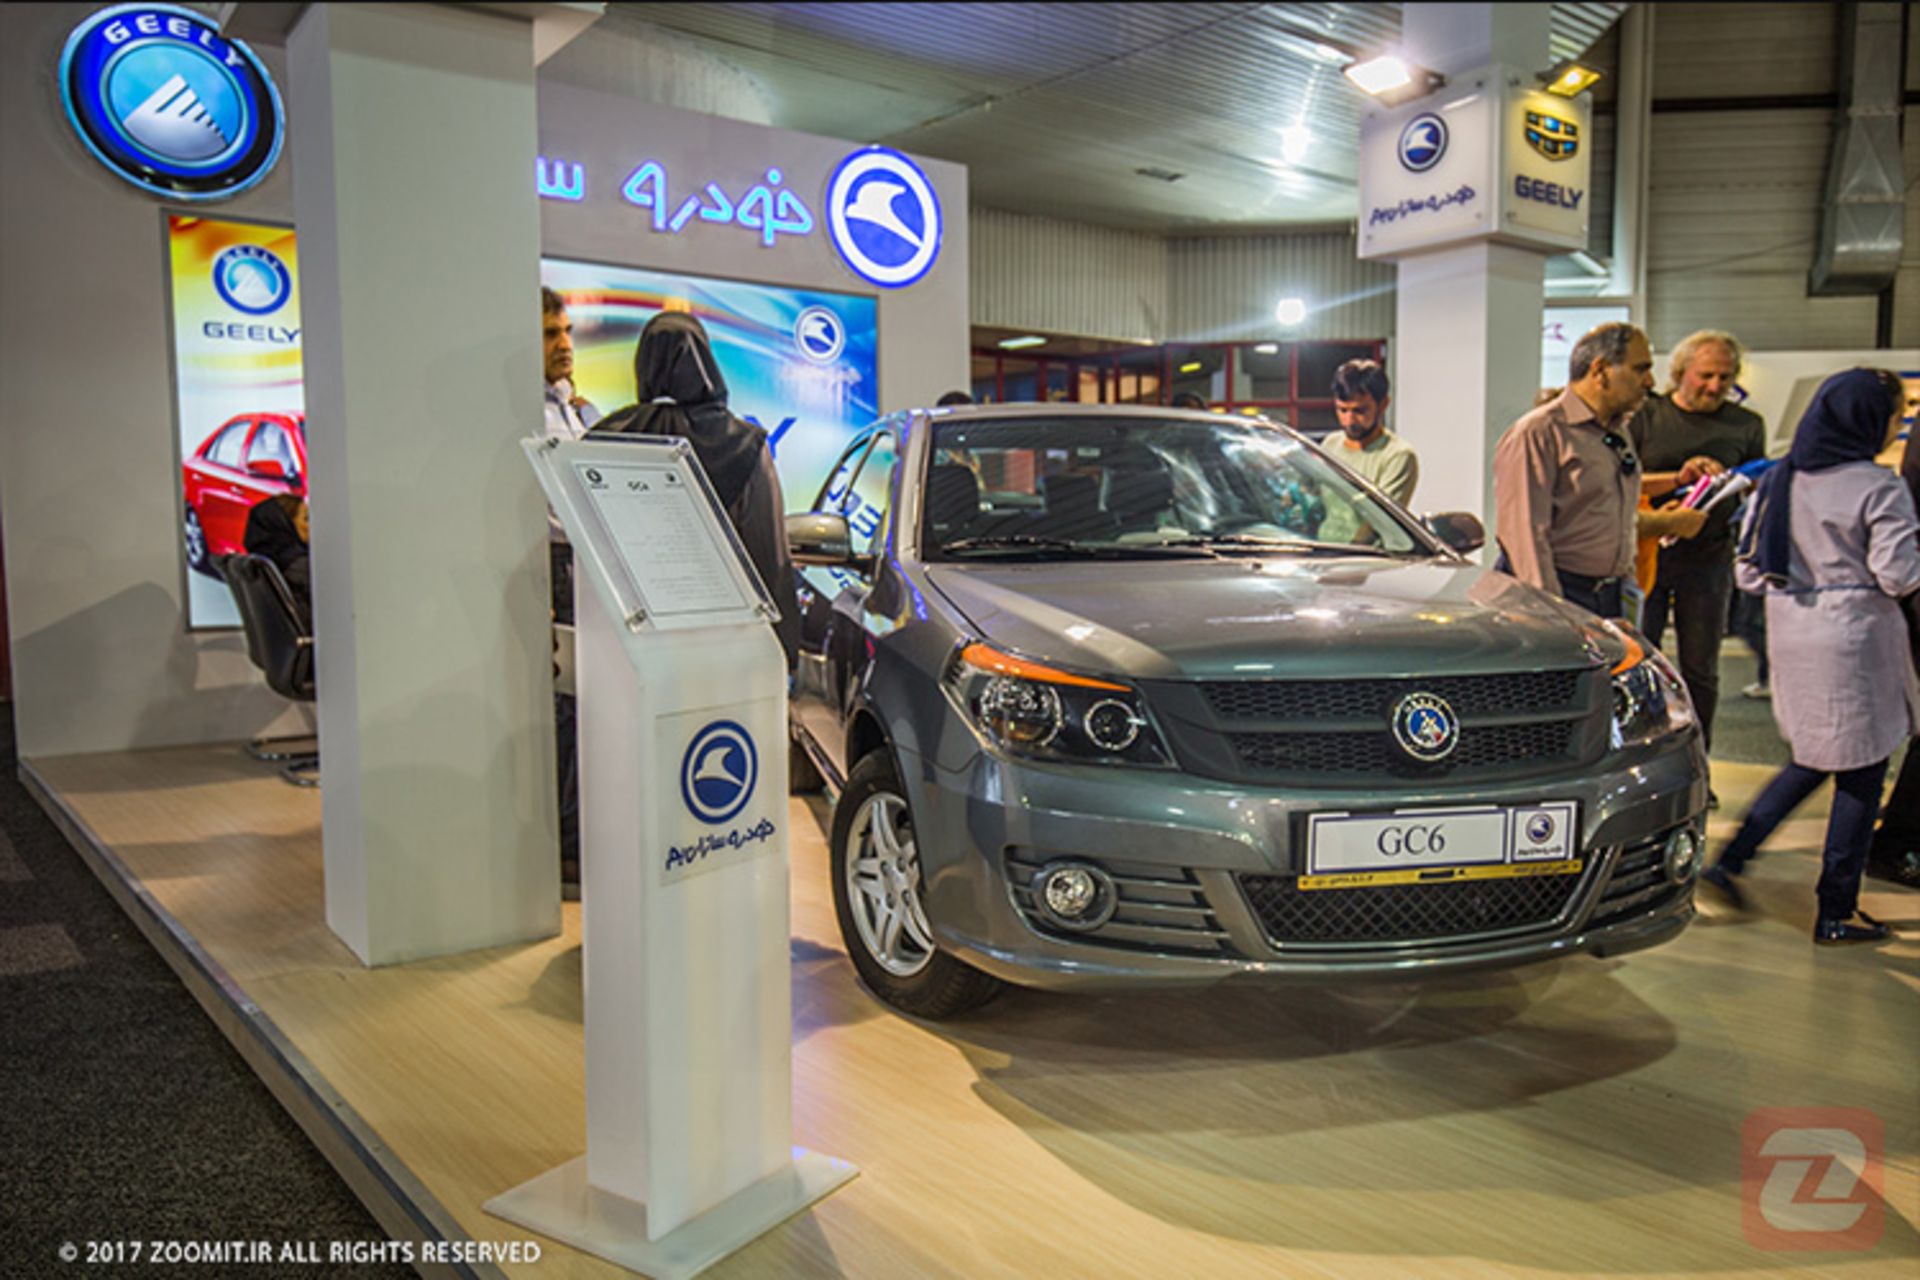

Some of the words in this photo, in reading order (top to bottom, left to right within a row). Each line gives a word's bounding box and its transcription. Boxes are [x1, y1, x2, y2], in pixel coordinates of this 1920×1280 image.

[103, 14, 245, 67] GEELY
[621, 160, 815, 247] خودرو
[1514, 173, 1583, 211] GEELY
[203, 321, 301, 343] GEELY
[728, 817, 775, 850] خودرو
[1377, 823, 1446, 856] GC6
